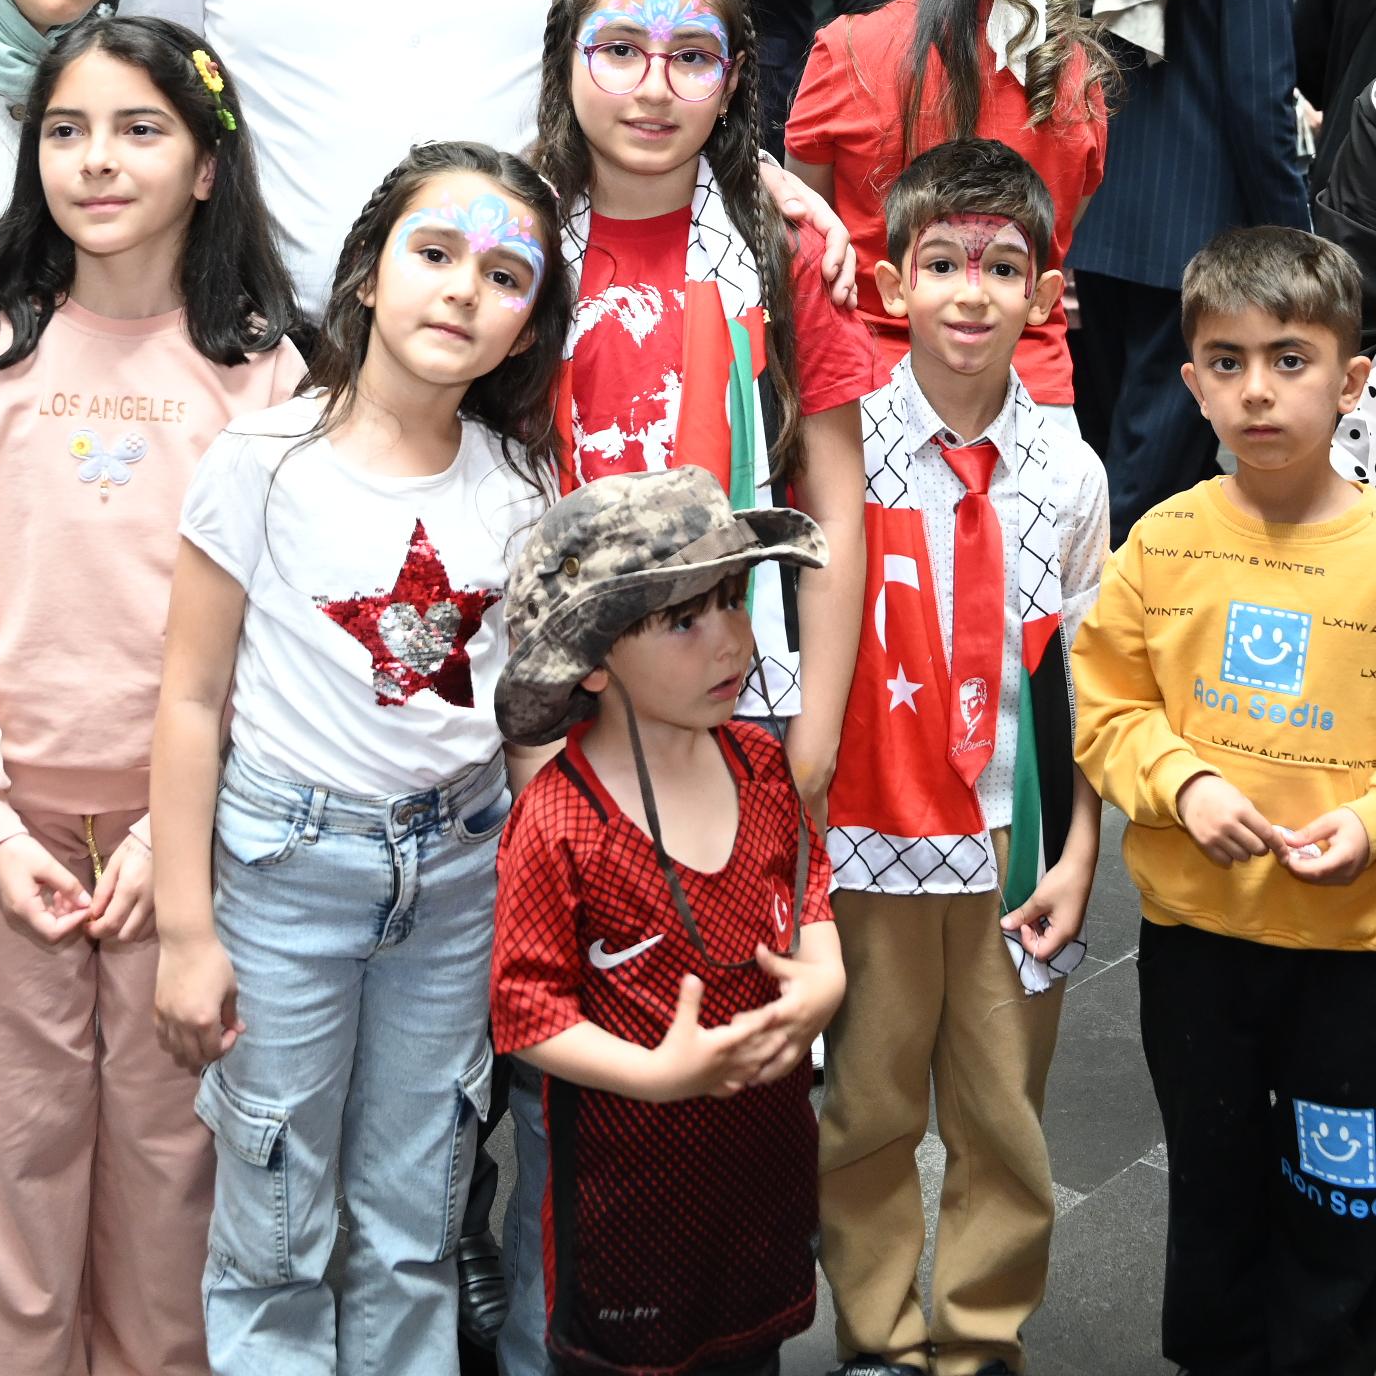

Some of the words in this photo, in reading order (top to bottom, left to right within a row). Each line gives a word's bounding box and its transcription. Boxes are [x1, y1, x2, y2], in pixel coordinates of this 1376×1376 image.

[39, 391, 81, 417] LOS
[86, 394, 187, 423] ANGELES
[1183, 550, 1245, 563] AUTUMN
[1264, 558, 1326, 577] WINTER
[1144, 606, 1194, 617] WINTER
[1322, 615, 1368, 632] LXHW
[1248, 694, 1336, 731] Sedis
